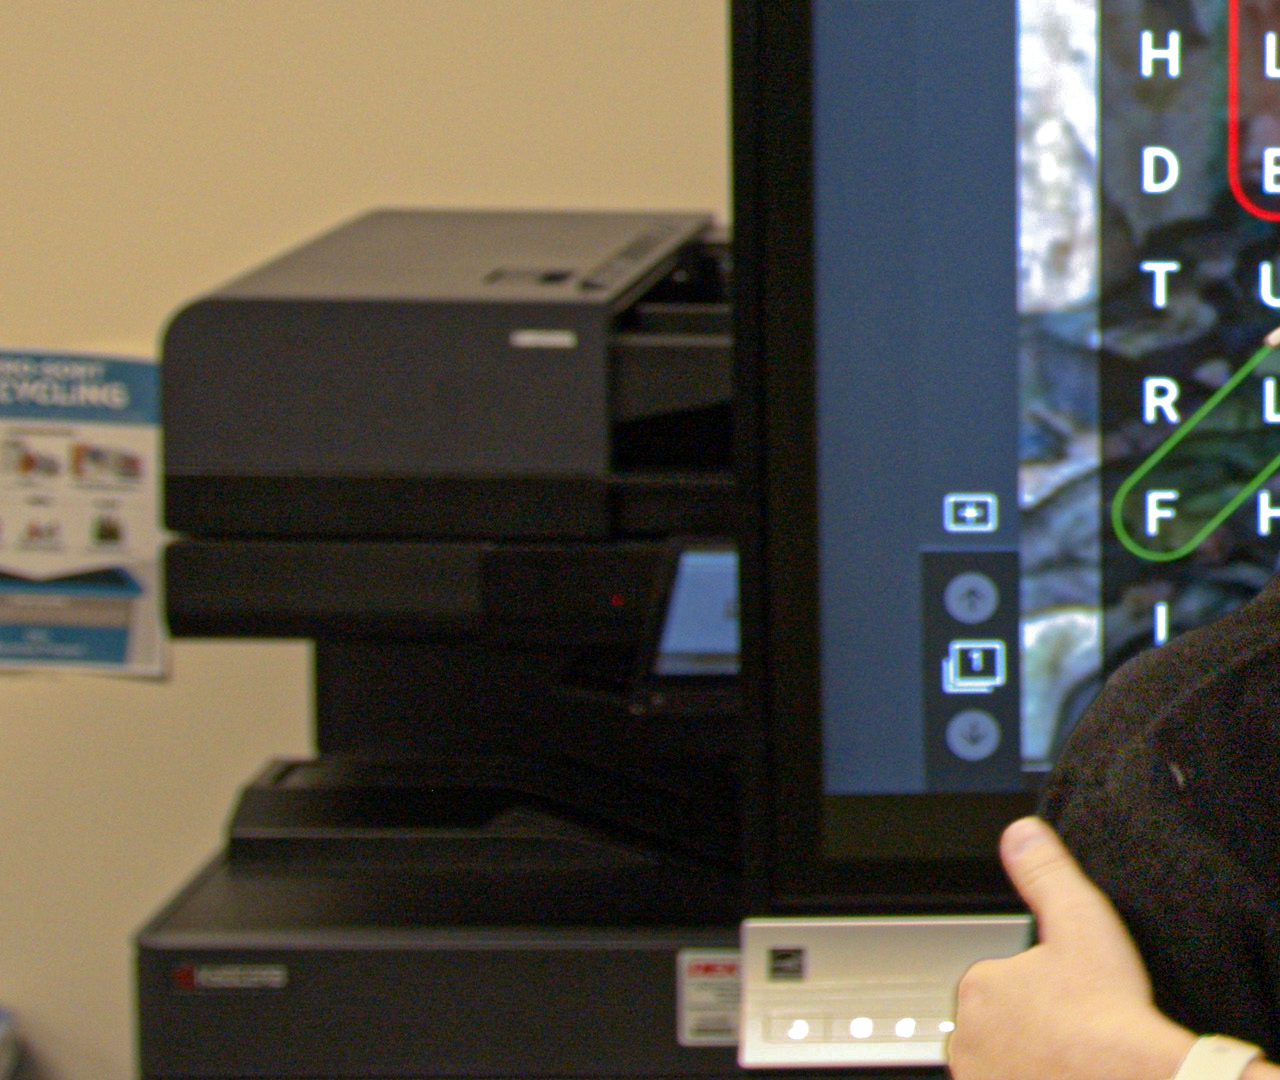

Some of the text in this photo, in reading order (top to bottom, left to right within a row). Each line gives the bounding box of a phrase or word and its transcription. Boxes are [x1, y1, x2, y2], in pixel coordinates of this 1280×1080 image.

[1140, 30, 1180, 78] H
[1142, 145, 1180, 194] D
[1142, 261, 1179, 308] T
[1144, 377, 1179, 423] R
[1146, 490, 1177, 535] F
